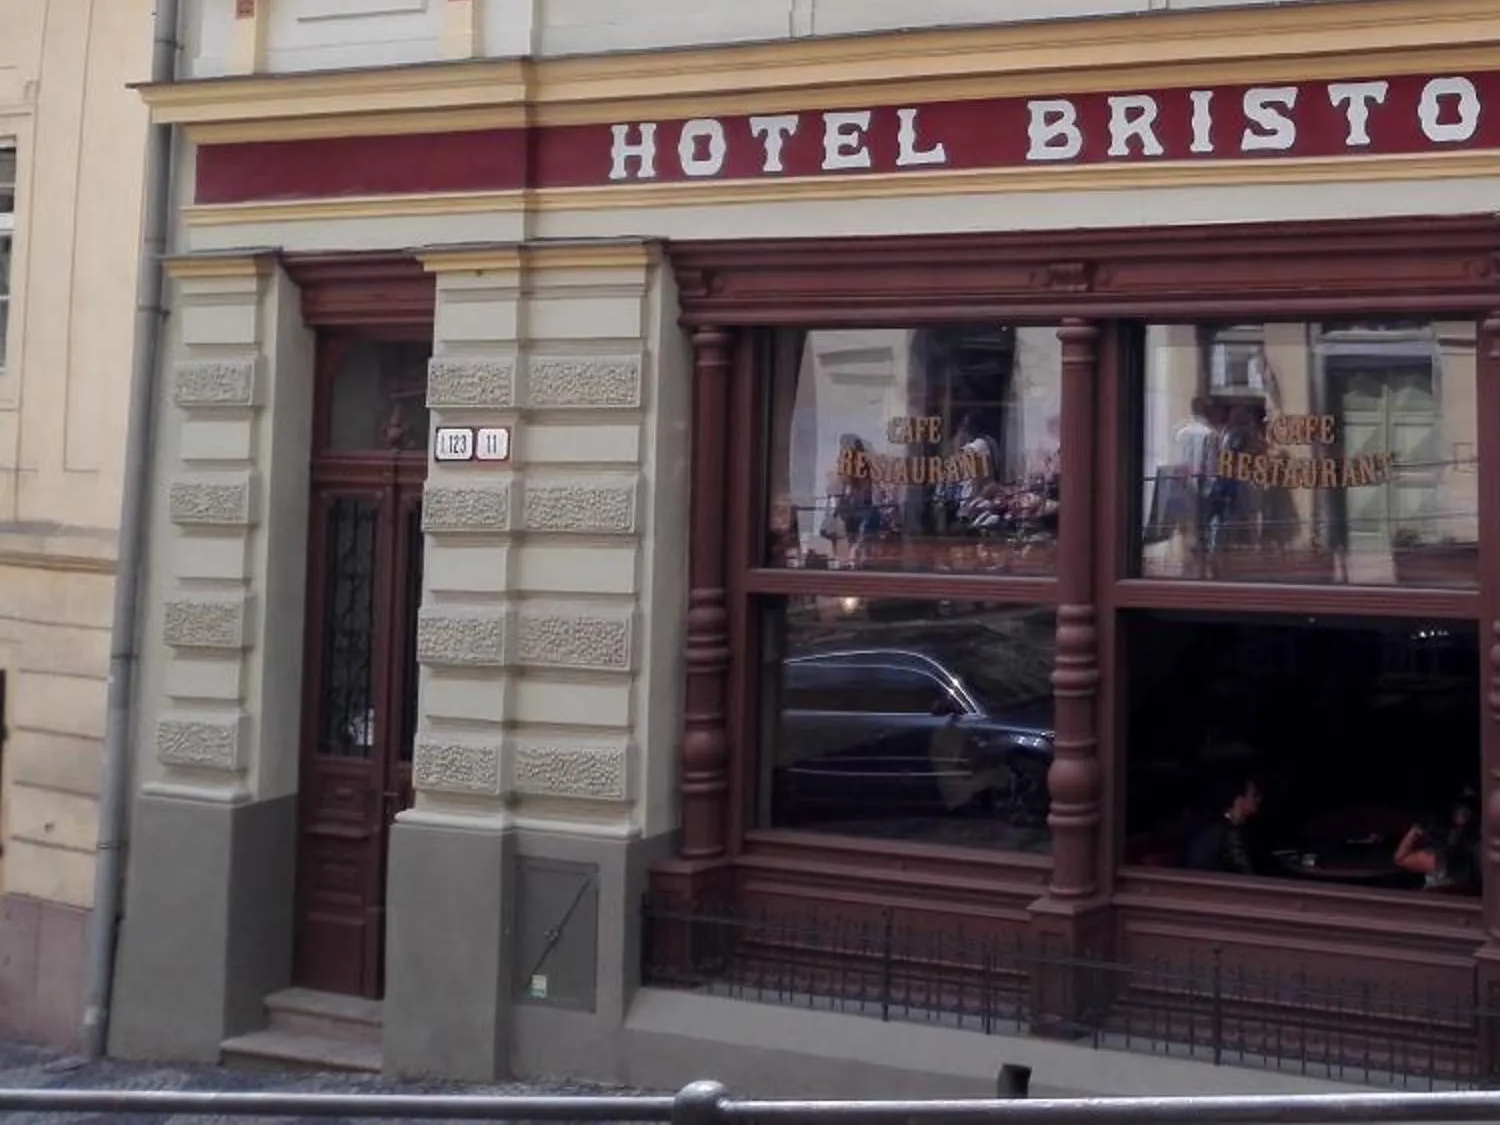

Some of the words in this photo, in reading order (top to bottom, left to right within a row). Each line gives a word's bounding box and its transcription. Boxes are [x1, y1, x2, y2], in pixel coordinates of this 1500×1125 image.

[608, 107, 947, 180] HOTEL
[887, 415, 944, 444] CAFE
[1271, 414, 1336, 445] CAFE
[838, 448, 993, 486] RESTAURANT
[1218, 449, 1396, 489] RESTAURANT
